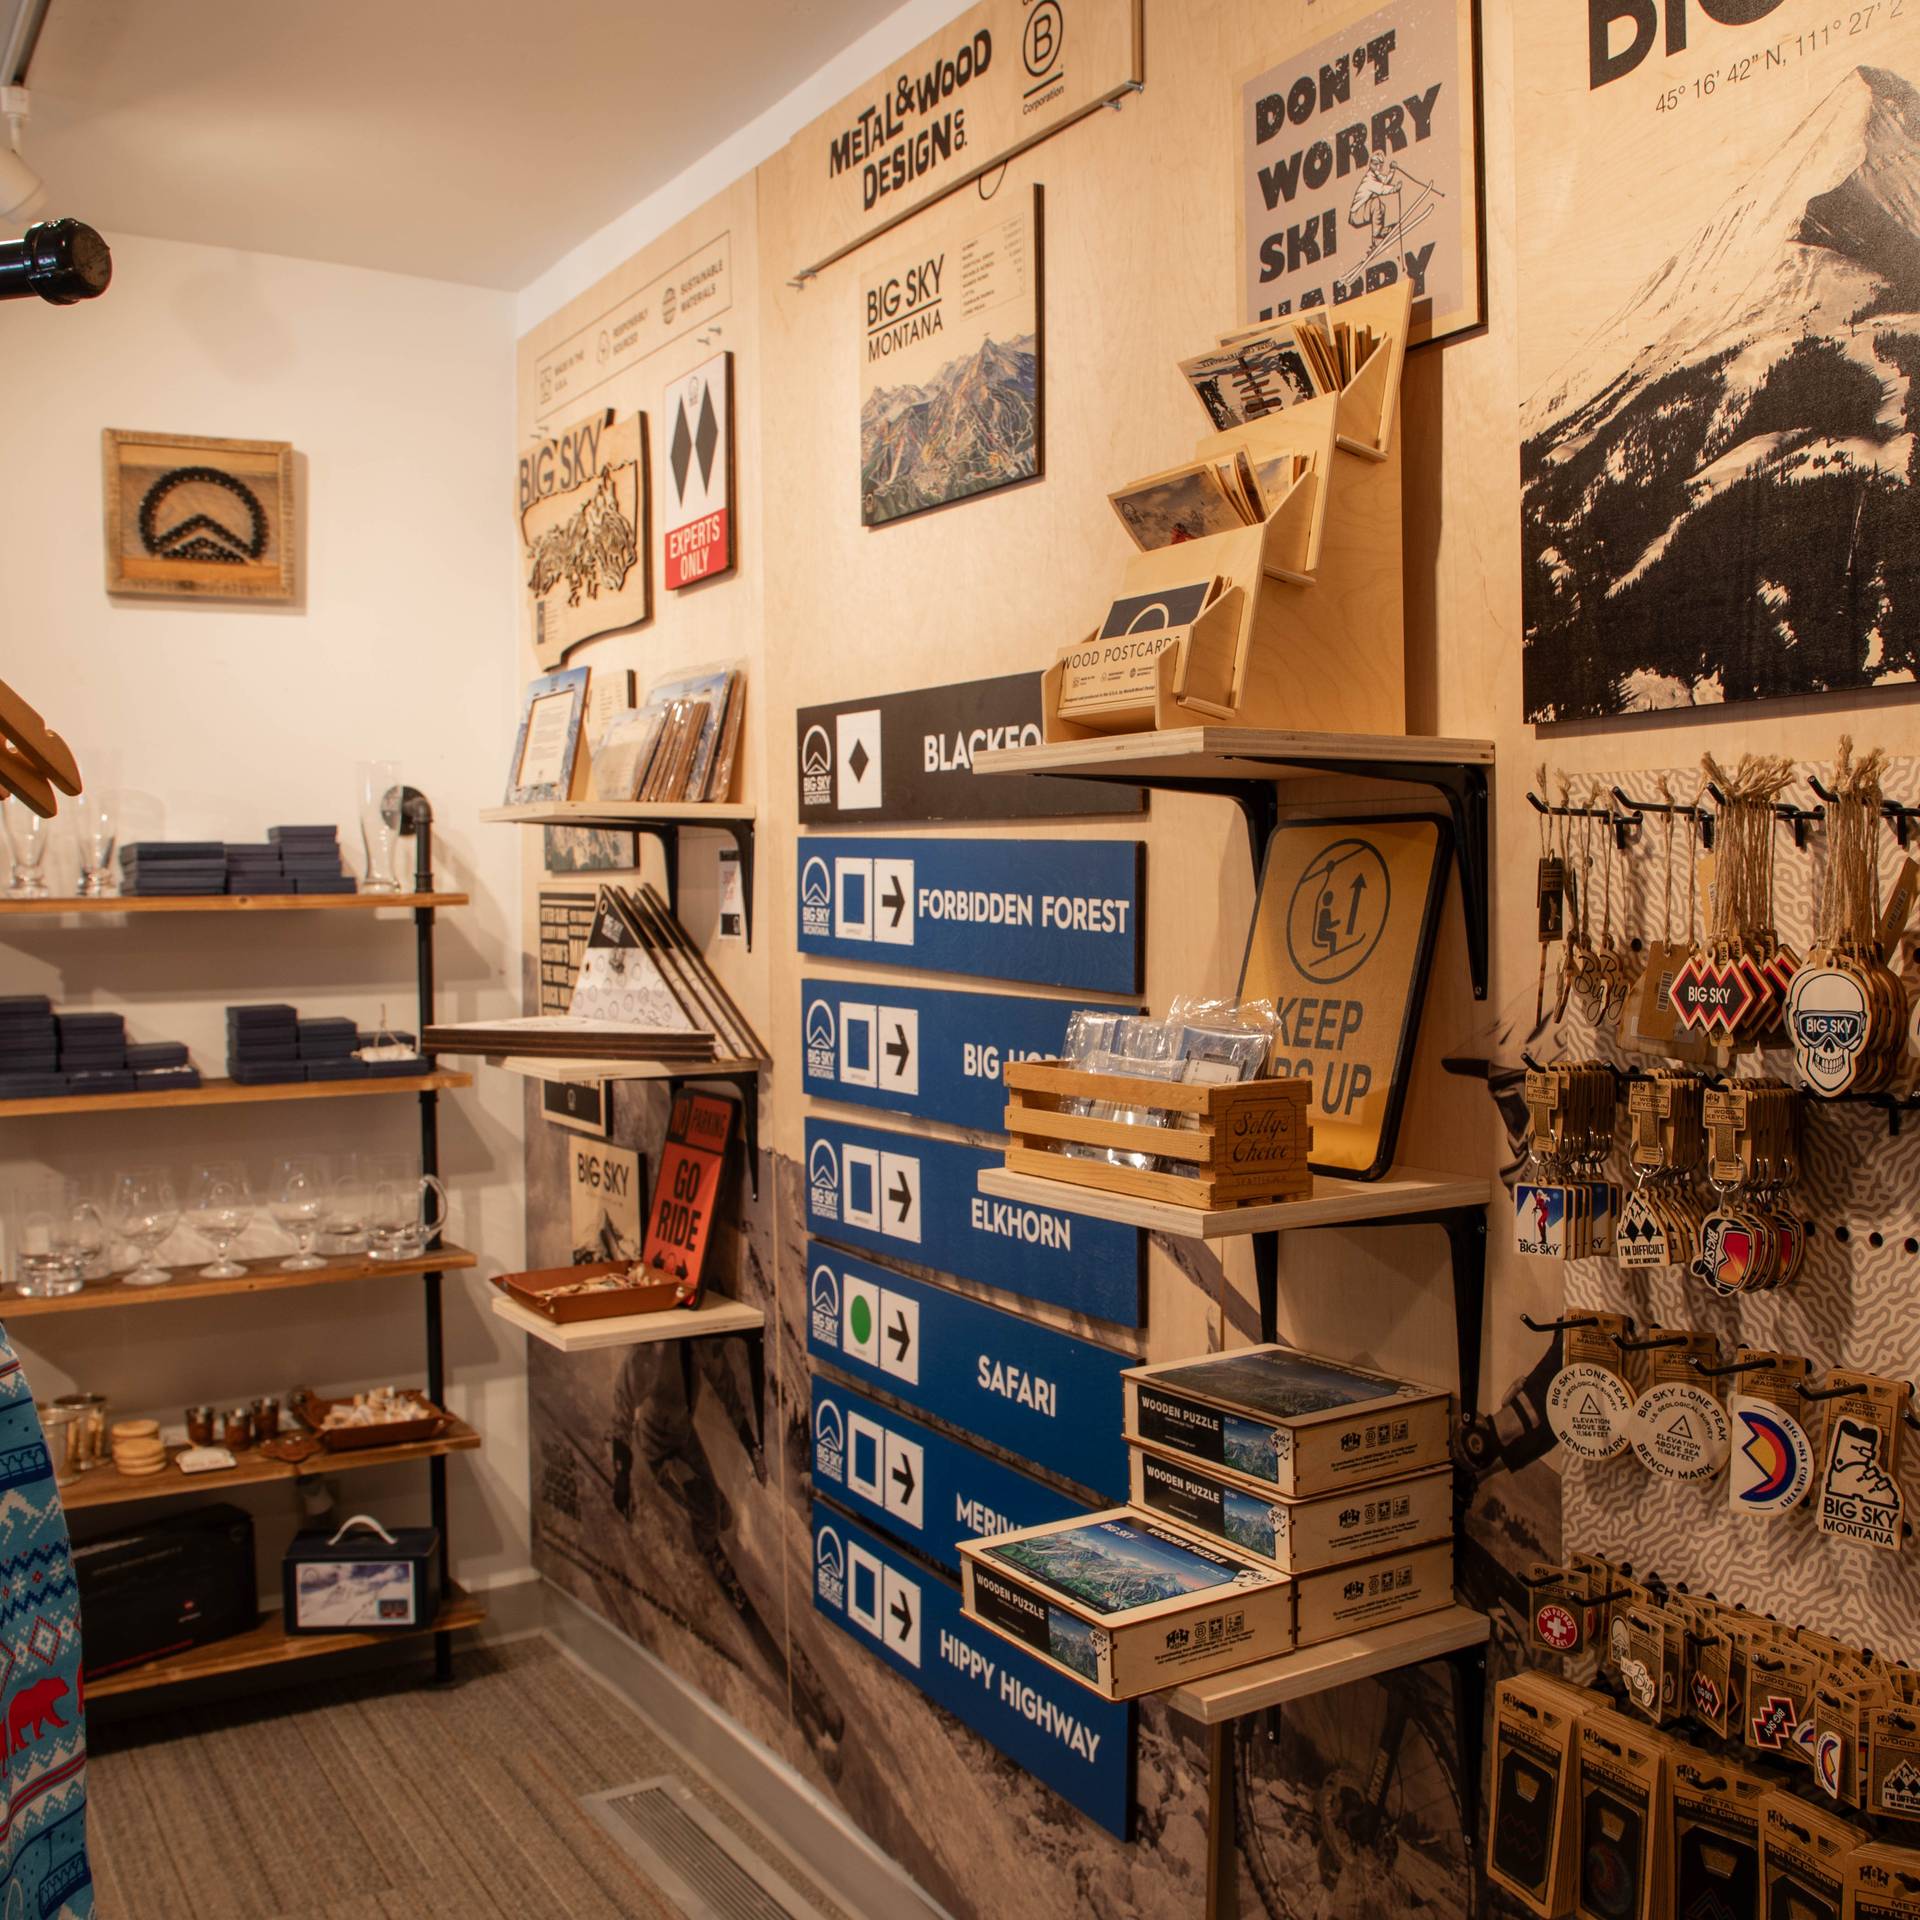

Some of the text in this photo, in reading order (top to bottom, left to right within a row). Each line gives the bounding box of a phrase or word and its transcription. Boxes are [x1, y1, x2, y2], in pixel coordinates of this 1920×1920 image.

[1766, 46, 1786, 70] N,
[1023, 86, 1064, 115] Corporation
[1255, 28, 1396, 146] DON'T
[864, 112, 952, 212] DESIGN
[1257, 82, 1443, 211] WORRY
[1259, 207, 1337, 284] SKI
[867, 278, 902, 328] BIG
[905, 253, 945, 308] SKY
[868, 309, 944, 363] MONTANA
[520, 418, 602, 513] BIG SKY
[670, 514, 721, 560] EXPERTS
[680, 547, 710, 581] ONLY
[1062, 650, 1100, 670] WOOD
[803, 774, 831, 793] BIG SKY
[802, 907, 830, 923] BIG SKY
[918, 888, 1130, 934] FORBIDDEN FOREST
[1688, 986, 1731, 1005] BIG SKY
[1276, 996, 1364, 1051] KEEP
[1806, 1017, 1853, 1034] BIG SKY
[808, 1049, 835, 1067] BIG SKY
[963, 1043, 999, 1080] BIG
[1322, 1061, 1372, 1117] UP
[1632, 1101, 1669, 1110] KEYCHAIN
[1706, 1114, 1744, 1122] KEYCHAIN
[1232, 1137, 1289, 1163] Choice
[577, 1152, 629, 1198] BIG SKY
[673, 1158, 700, 1204] GO
[655, 1200, 702, 1252] RIDE
[971, 1197, 1071, 1252] ELKHORN
[1519, 1243, 1560, 1256] BIG SKY
[1620, 1243, 1665, 1256] I'M DIFFICULT
[1703, 1226, 1719, 1271] BIG SKY
[977, 1354, 1056, 1417] SAFARI
[1552, 1368, 1629, 1410] BIG SKY LONE PEAK
[1565, 1381, 1618, 1412] GEOLOGICAL SURVEY
[1141, 1396, 1181, 1418] WOODEN
[1183, 1408, 1219, 1431] PUZZLE
[1572, 1417, 1610, 1425] ELEVATION
[1637, 1388, 1727, 1441] BIG SKY LONE PEAK
[1658, 1401, 1713, 1440] GEOLOGICAL SURVEY
[1838, 1406, 1883, 1418] MAGNET
[1845, 1401, 1877, 1412] WOOD
[1559, 1430, 1627, 1457] BENCH MARK
[1654, 1440, 1700, 1457] ABOVE SEA
[1656, 1433, 1701, 1450] ELEVATION
[1637, 1443, 1715, 1480] BENCH MARK
[1679, 1454, 1696, 1462] FEET
[1780, 1418, 1808, 1507] BIG SKY COUNTRY
[1147, 1465, 1185, 1493] WOODEN
[1186, 1480, 1220, 1504] PUZZLE
[1824, 1496, 1899, 1529] BIG SKY
[1100, 1523, 1138, 1540] BIG SKY
[1147, 1527, 1229, 1564] WOODEN PUZZLE
[1823, 1519, 1894, 1546] MONTANA
[976, 1572, 1011, 1603] WOODEN
[1012, 1590, 1046, 1621] PUZZLE
[1541, 1607, 1574, 1629] SKI PATROL
[1543, 1632, 1555, 1644] BIG
[940, 1629, 1101, 1764] HIPPY HIGHWAY
[1755, 1673, 1804, 1693] WOOD PIN
[1502, 1724, 1528, 1741] BOTTLE
[1764, 1707, 1786, 1737] BIG SKY
[1820, 1710, 1840, 1725] WOOD
[1583, 1760, 1646, 1797] BOTTLE OPENER
[1677, 1799, 1718, 1817] BOTTLE
[1701, 1796, 1737, 1813] METAL
[1768, 1844, 1840, 1889] BOTTLE OPENER
[1788, 1845, 1818, 1868] METAL
